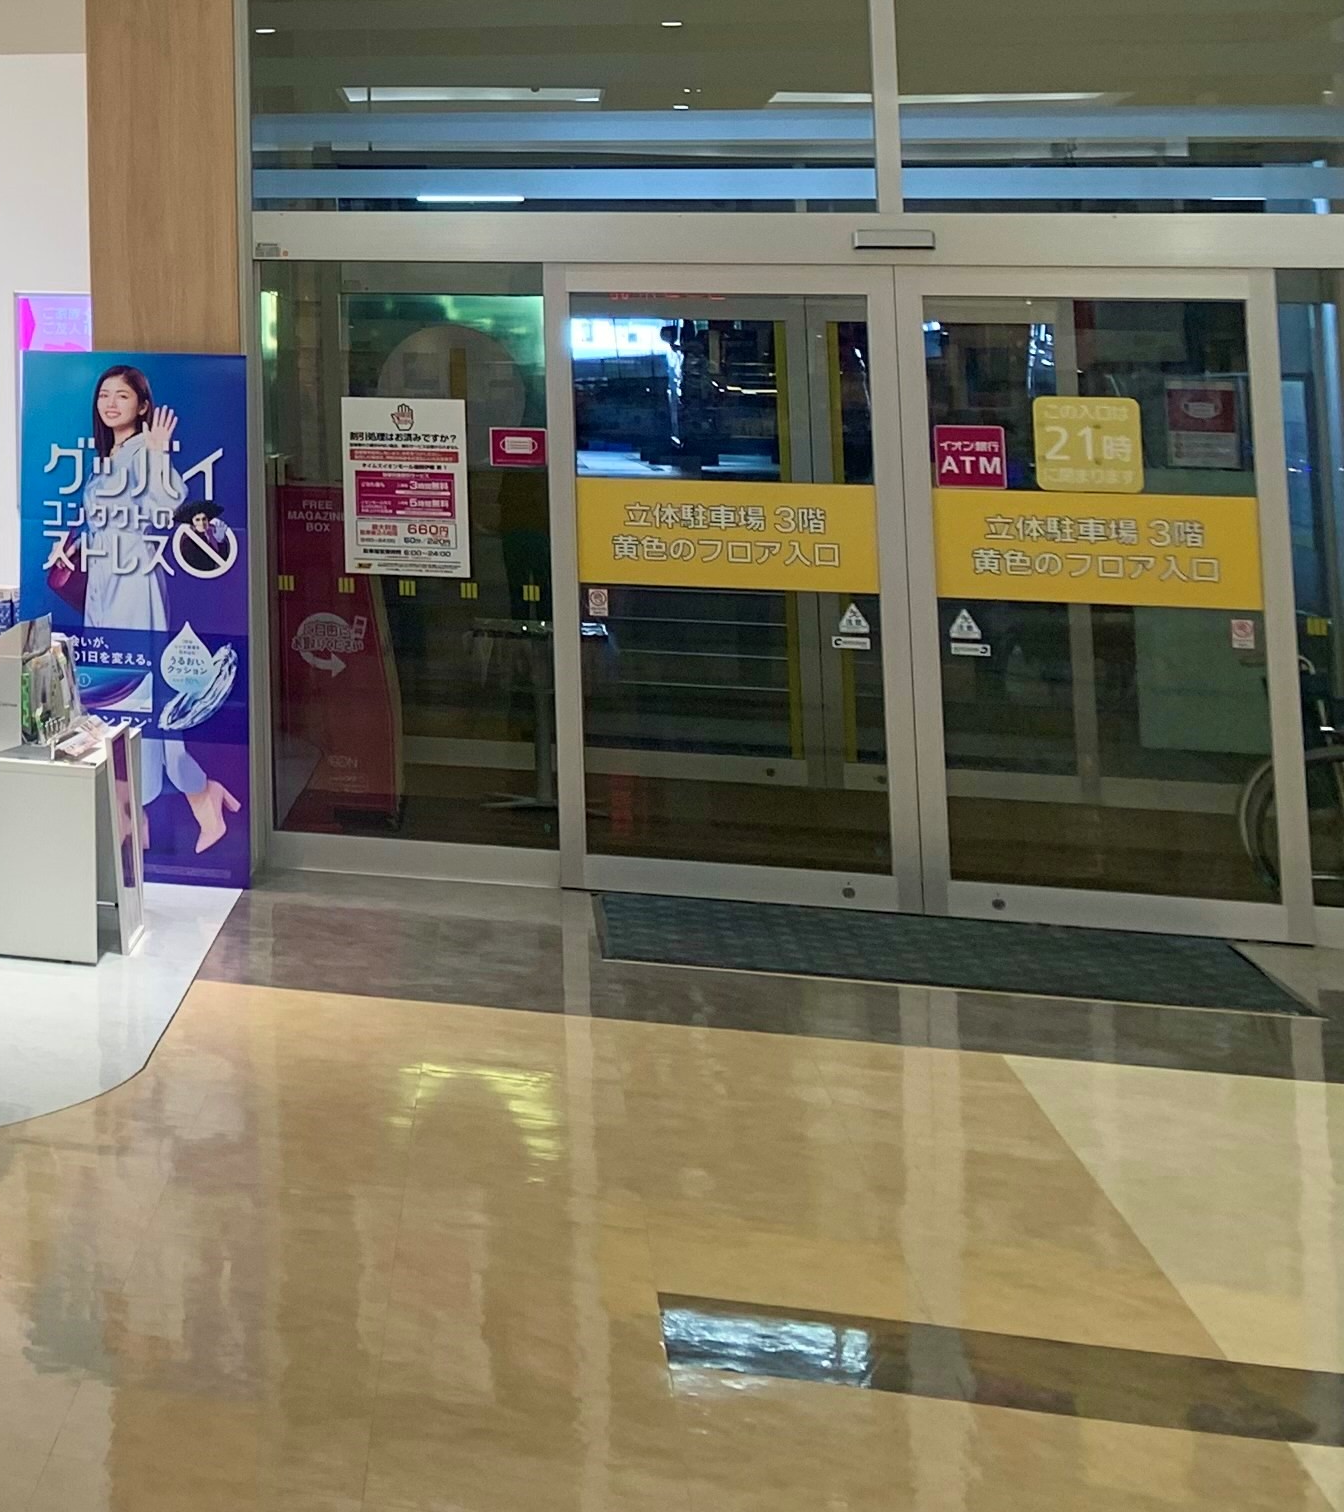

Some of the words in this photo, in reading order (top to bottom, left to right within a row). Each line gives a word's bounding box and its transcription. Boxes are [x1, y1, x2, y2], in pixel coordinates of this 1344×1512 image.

[1043, 404, 1129, 422] この入口は
[939, 440, 1000, 453] イオン銀行
[1043, 424, 1134, 463] 21時
[43, 436, 224, 501] グッバイ
[940, 455, 1002, 476] ATM
[42, 500, 175, 529] コンタクトの
[302, 499, 333, 509] FREE
[288, 510, 345, 521] MAGAZIN
[623, 502, 767, 531] 立体駐車場
[773, 506, 827, 535] 3階
[305, 522, 331, 533] BOX
[407, 524, 449, 537] 660円
[983, 515, 1139, 544] 立体駐車場
[1148, 520, 1205, 548] 3階
[42, 530, 176, 576] ストレス
[611, 534, 841, 568] 黄色のフロア入口
[971, 548, 1221, 584] 黄色のフロア入口
[167, 665, 208, 676] クッション
[169, 656, 205, 666] うるおい
